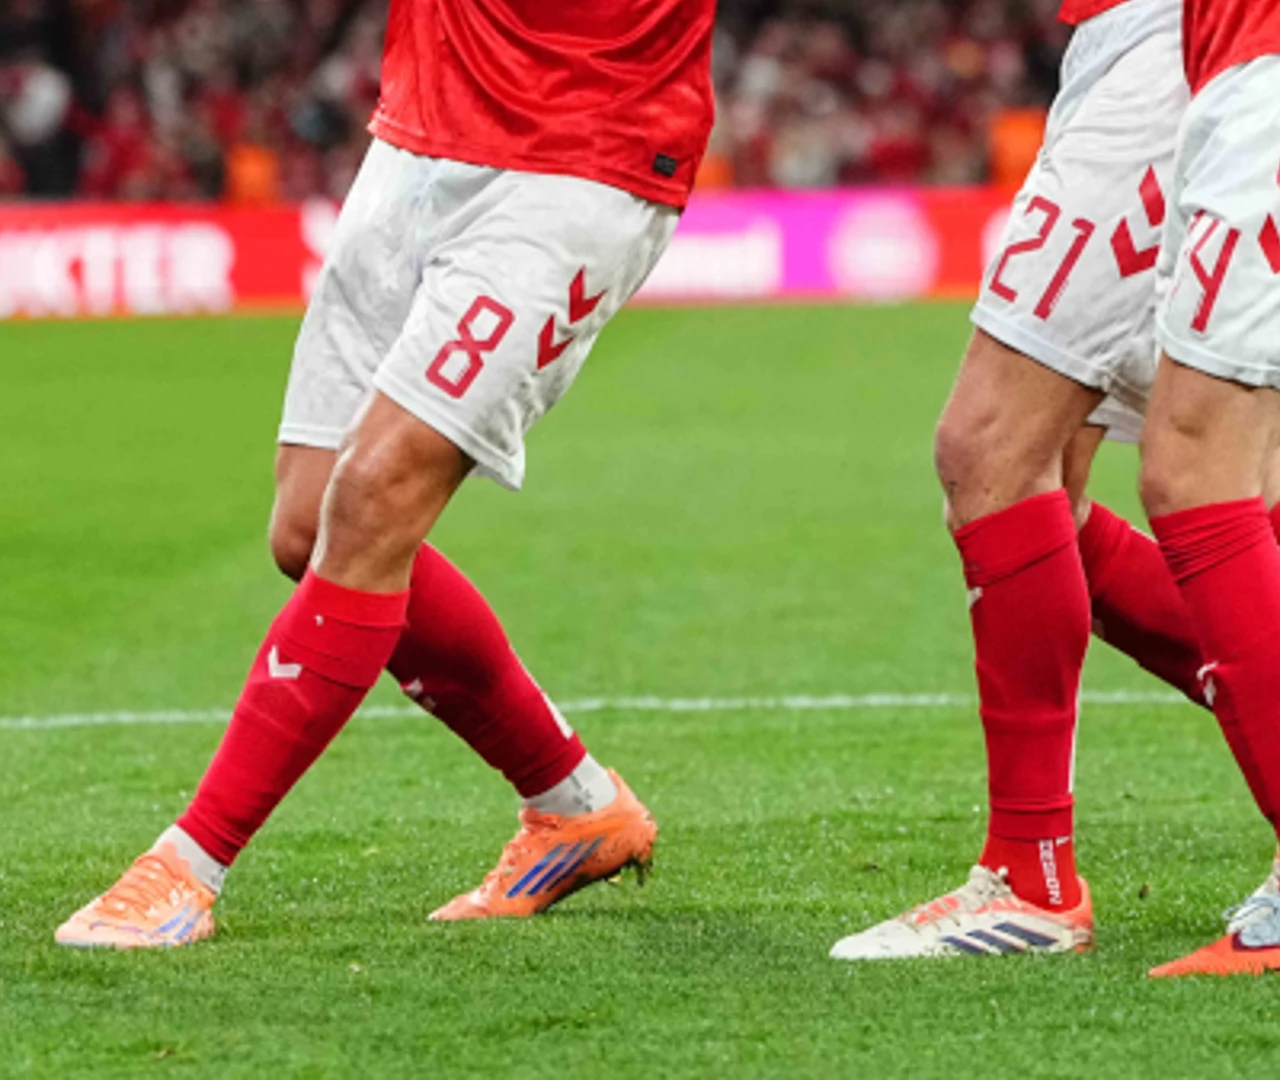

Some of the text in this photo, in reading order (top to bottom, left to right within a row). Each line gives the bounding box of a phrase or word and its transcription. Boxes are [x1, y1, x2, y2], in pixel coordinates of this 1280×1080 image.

[989, 195, 1097, 321] 21
[1180, 210, 1242, 333] 4
[425, 295, 516, 399] 8
